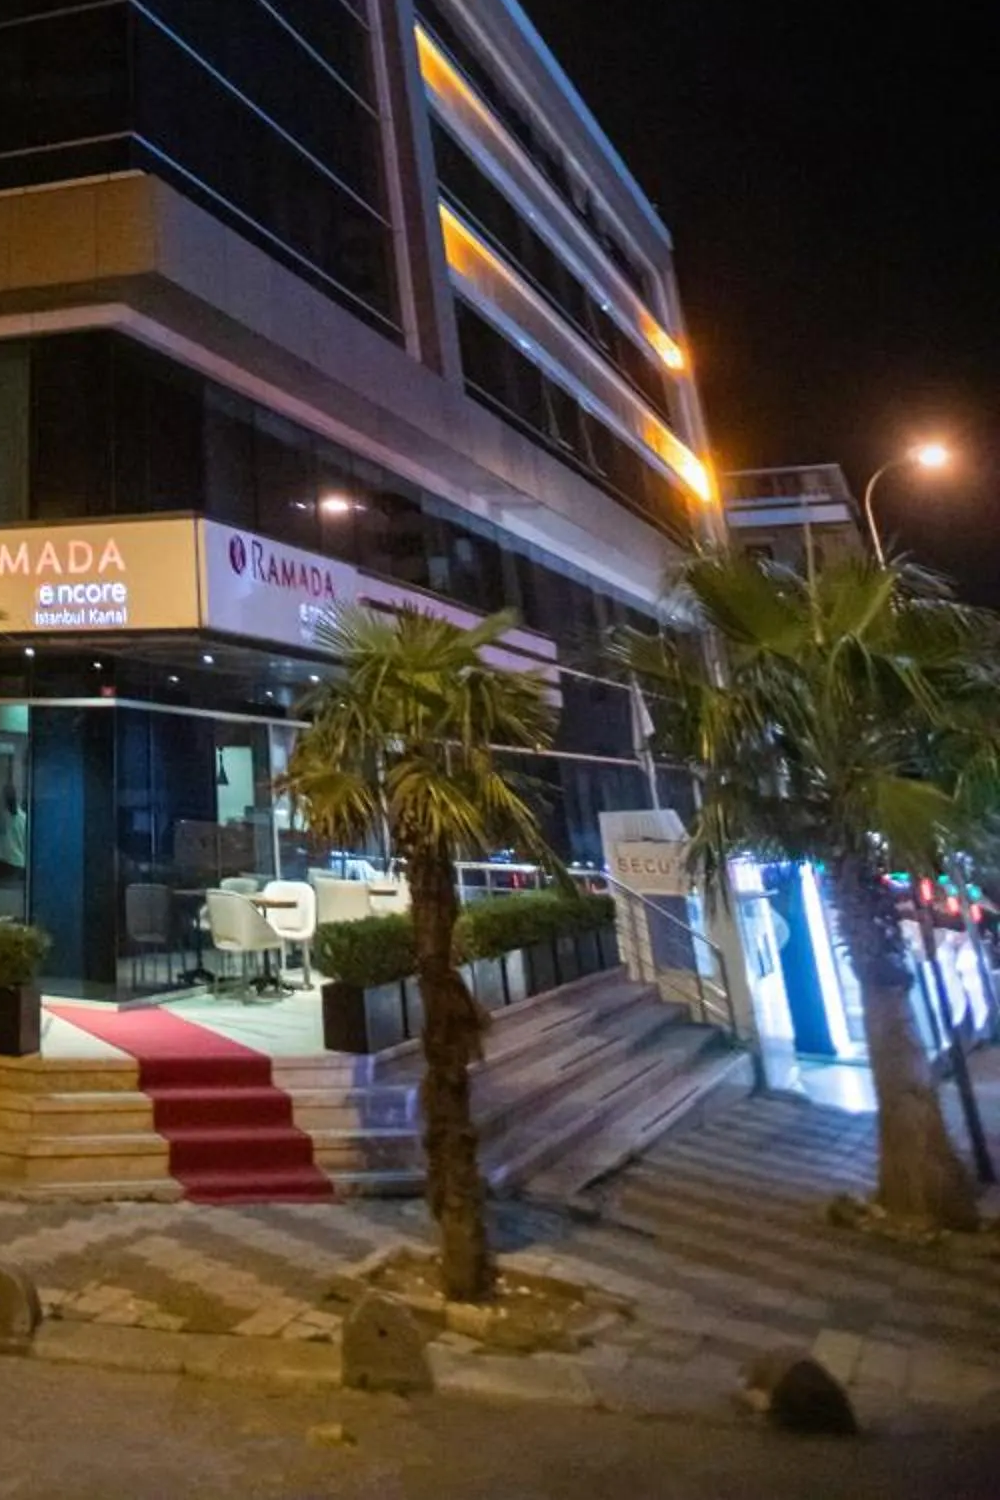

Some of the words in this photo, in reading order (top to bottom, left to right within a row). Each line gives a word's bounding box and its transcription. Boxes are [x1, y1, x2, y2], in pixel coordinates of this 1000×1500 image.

[250, 539, 336, 599] RAMADA
[39, 581, 128, 606] encore
[617, 856, 677, 876] SECU
